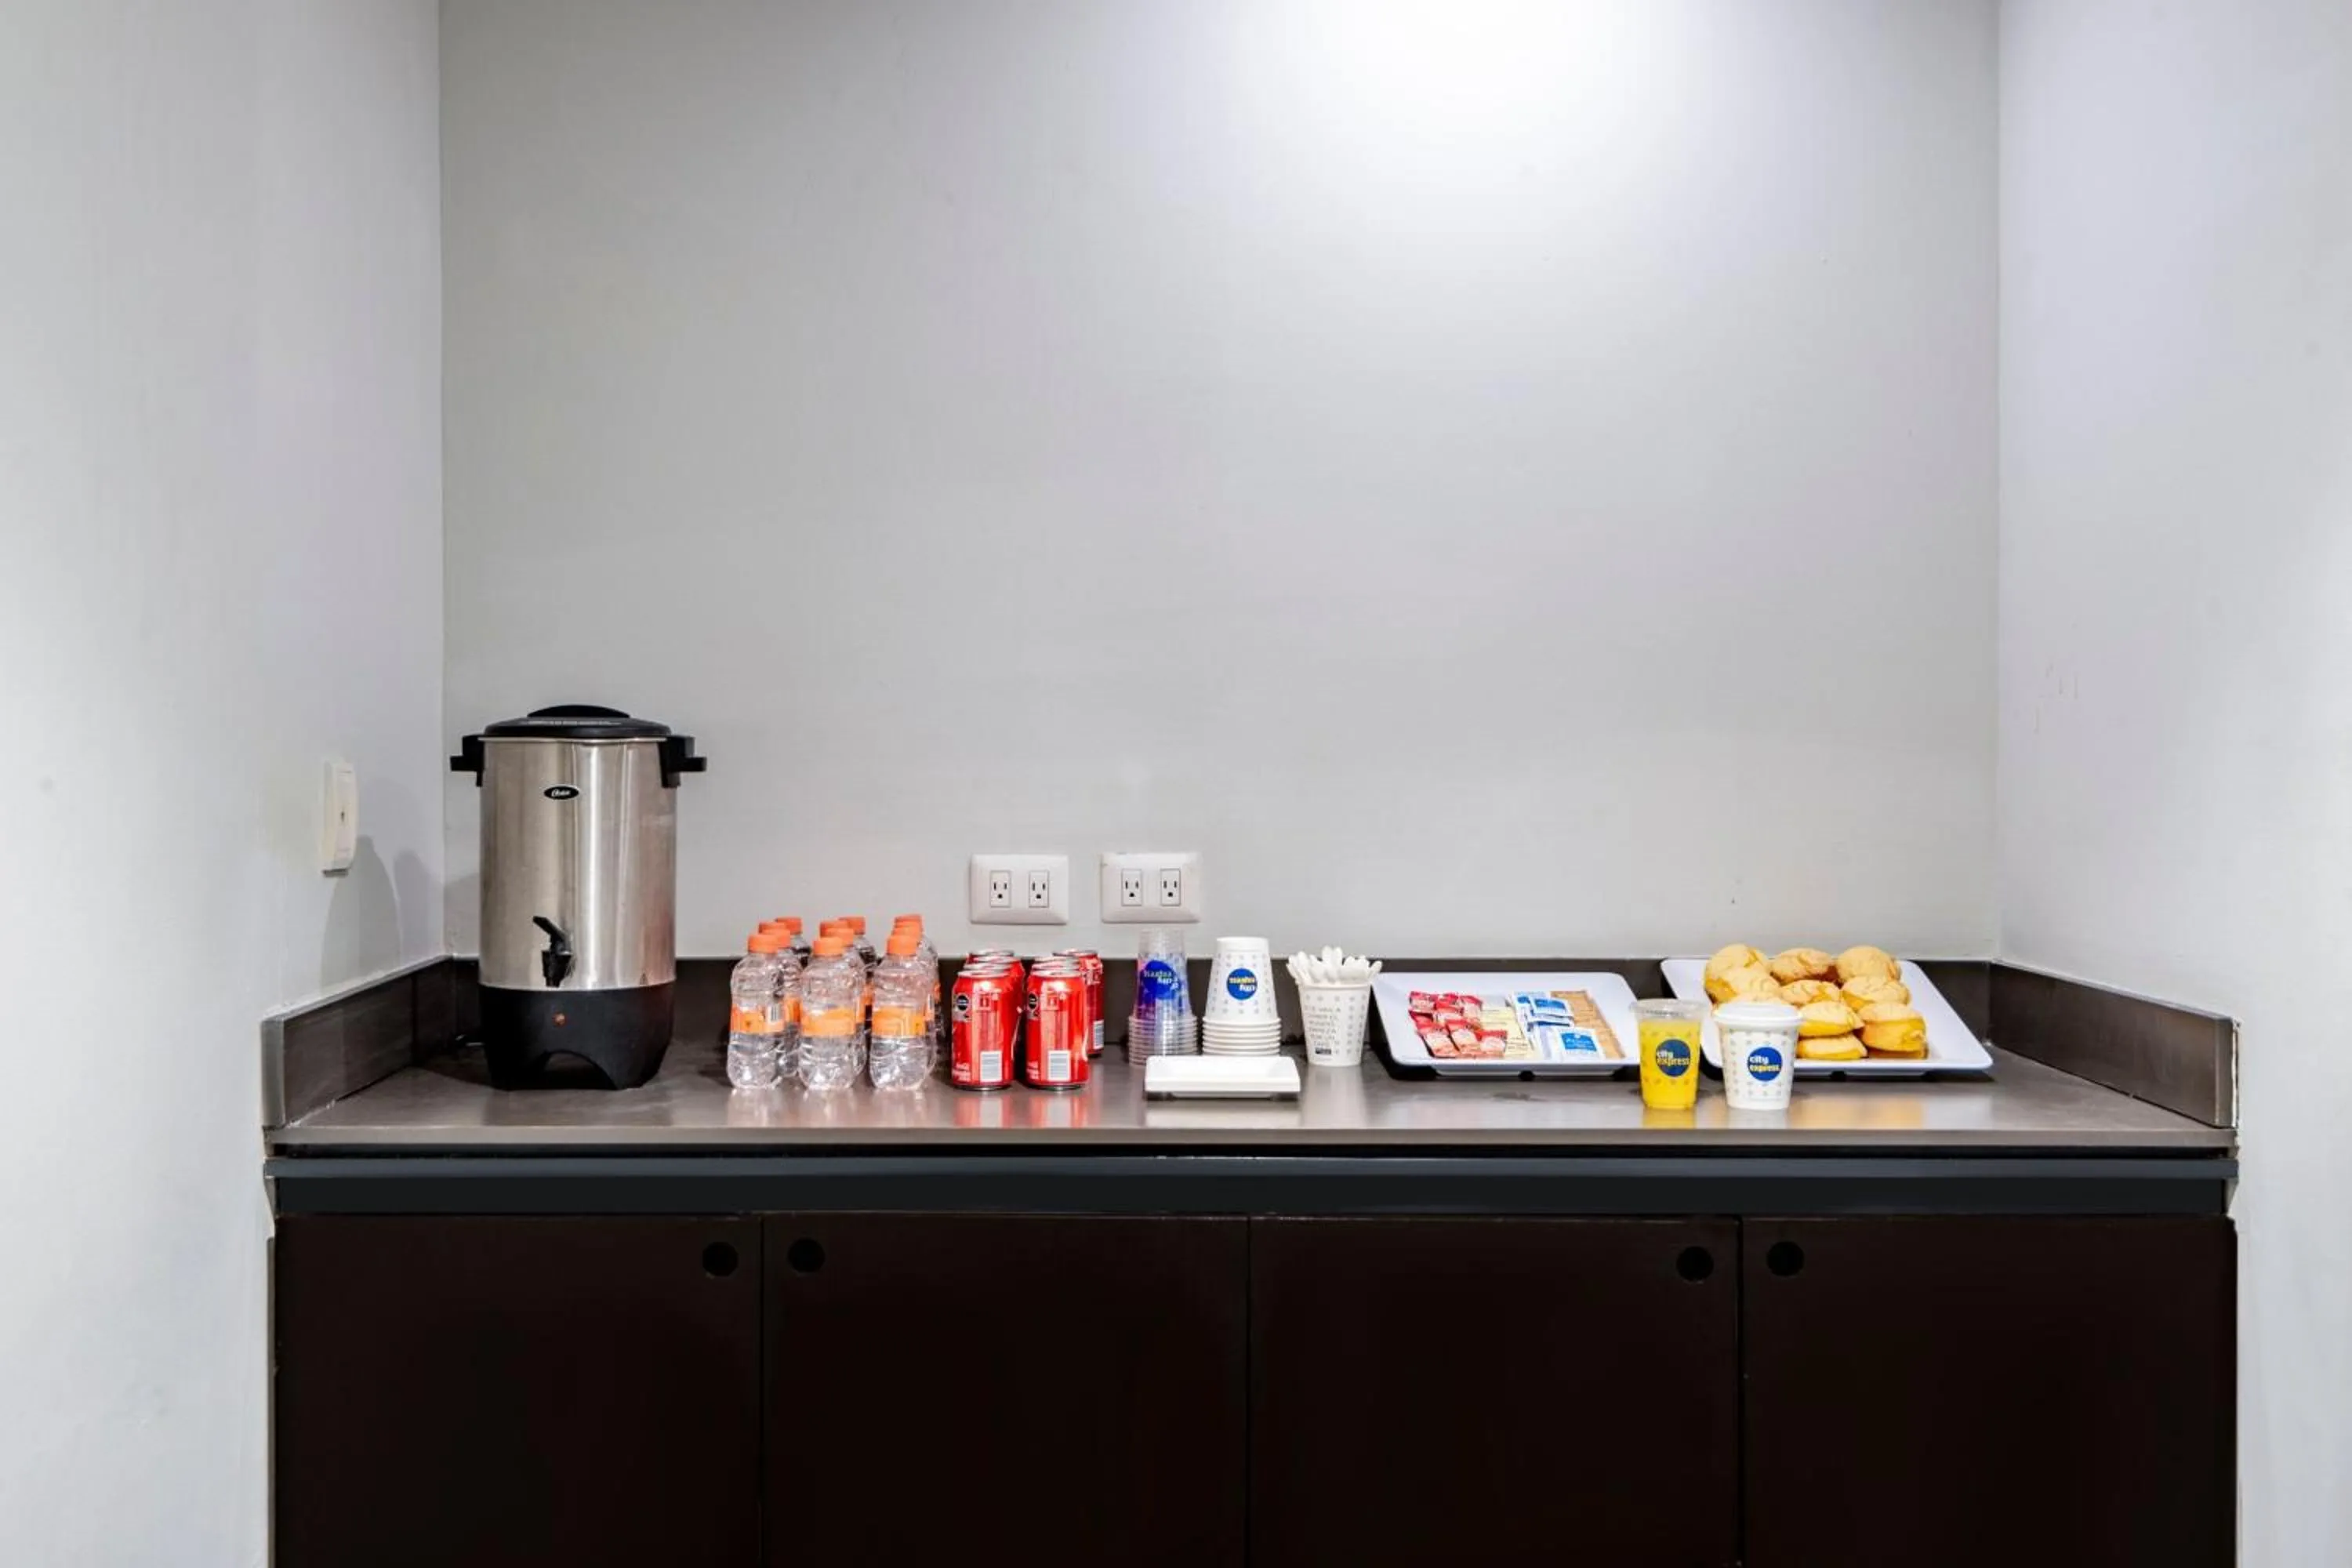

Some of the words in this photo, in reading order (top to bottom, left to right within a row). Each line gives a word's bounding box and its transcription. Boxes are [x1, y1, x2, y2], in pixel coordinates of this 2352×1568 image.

[1656, 1050, 1674, 1059] city
[1656, 1058, 1690, 1067] express
[1749, 1055, 1769, 1065] city
